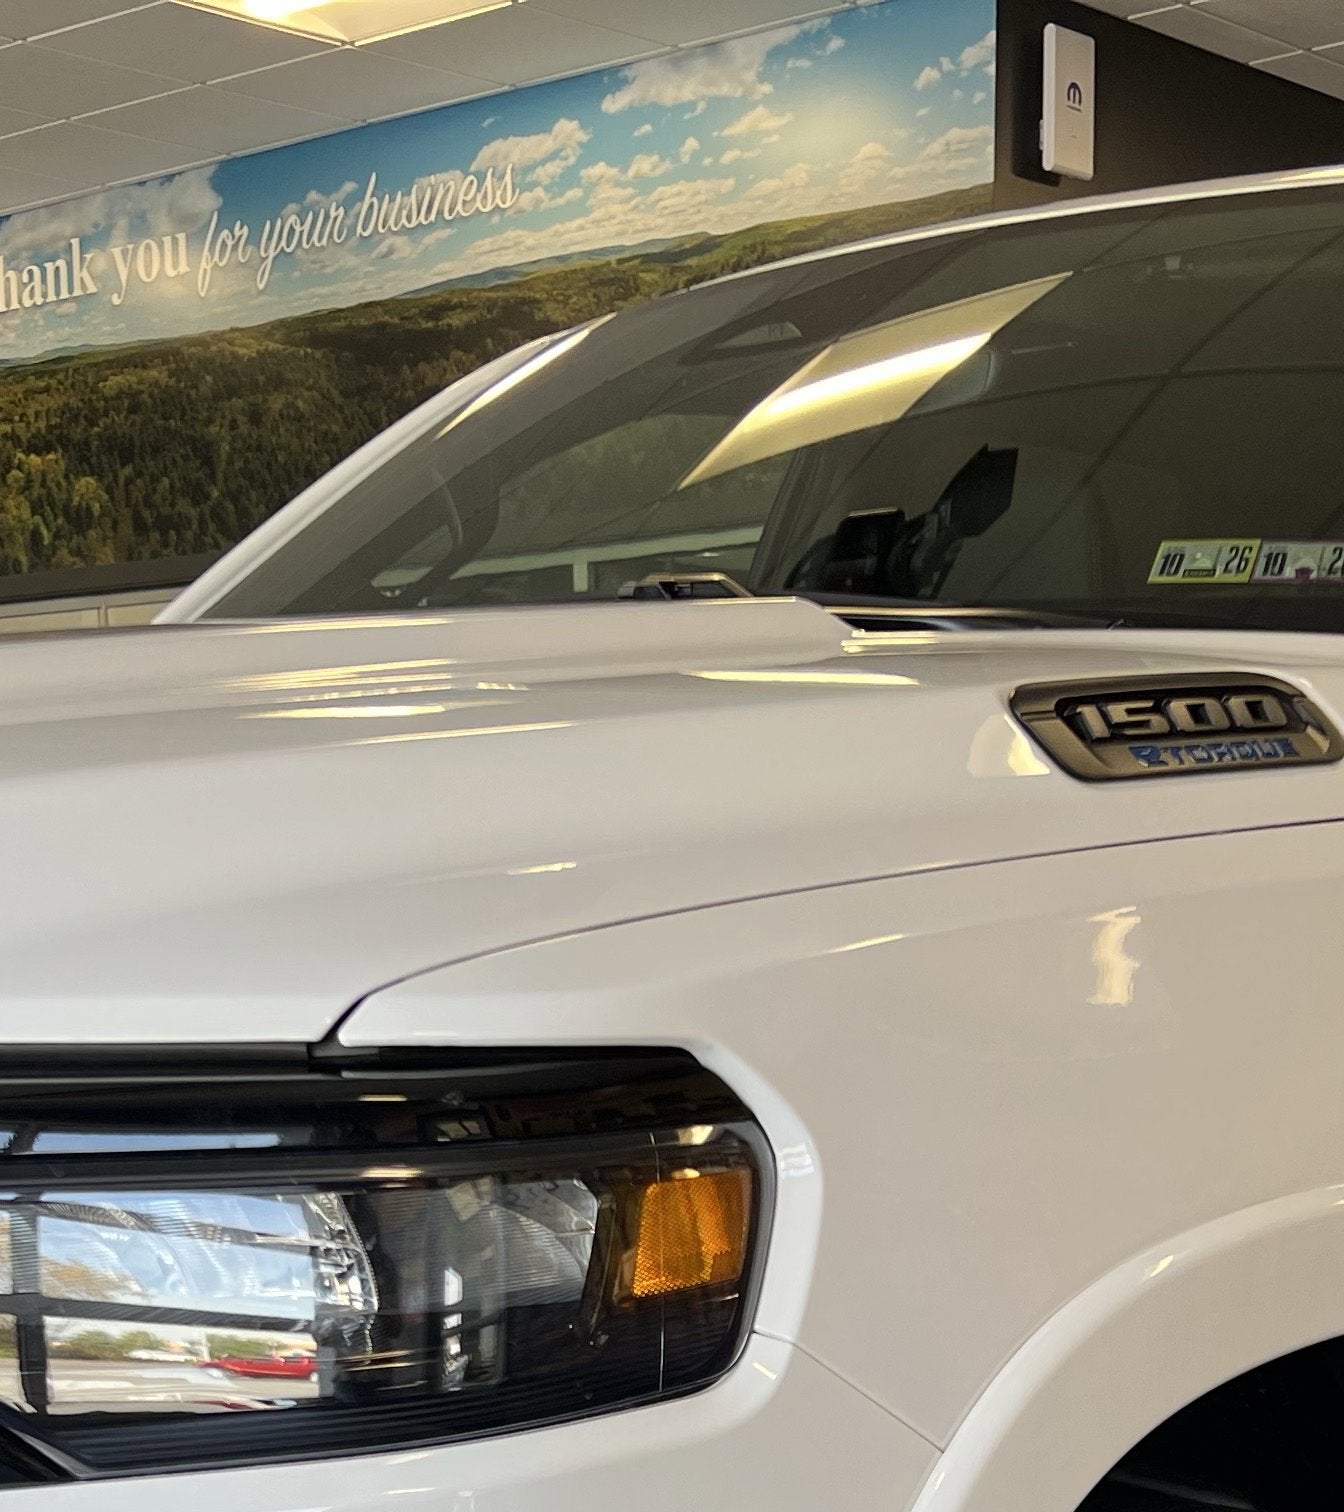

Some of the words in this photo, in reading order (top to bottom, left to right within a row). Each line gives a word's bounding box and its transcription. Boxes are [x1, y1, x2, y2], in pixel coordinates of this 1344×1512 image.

[109, 233, 189, 306] you
[196, 211, 253, 297] for
[255, 204, 348, 291] your
[355, 163, 519, 238] business
[1158, 553, 1185, 577] 10
[1222, 546, 1253, 575] 26
[1262, 552, 1287, 577] 10
[1063, 694, 1288, 742] 1500
